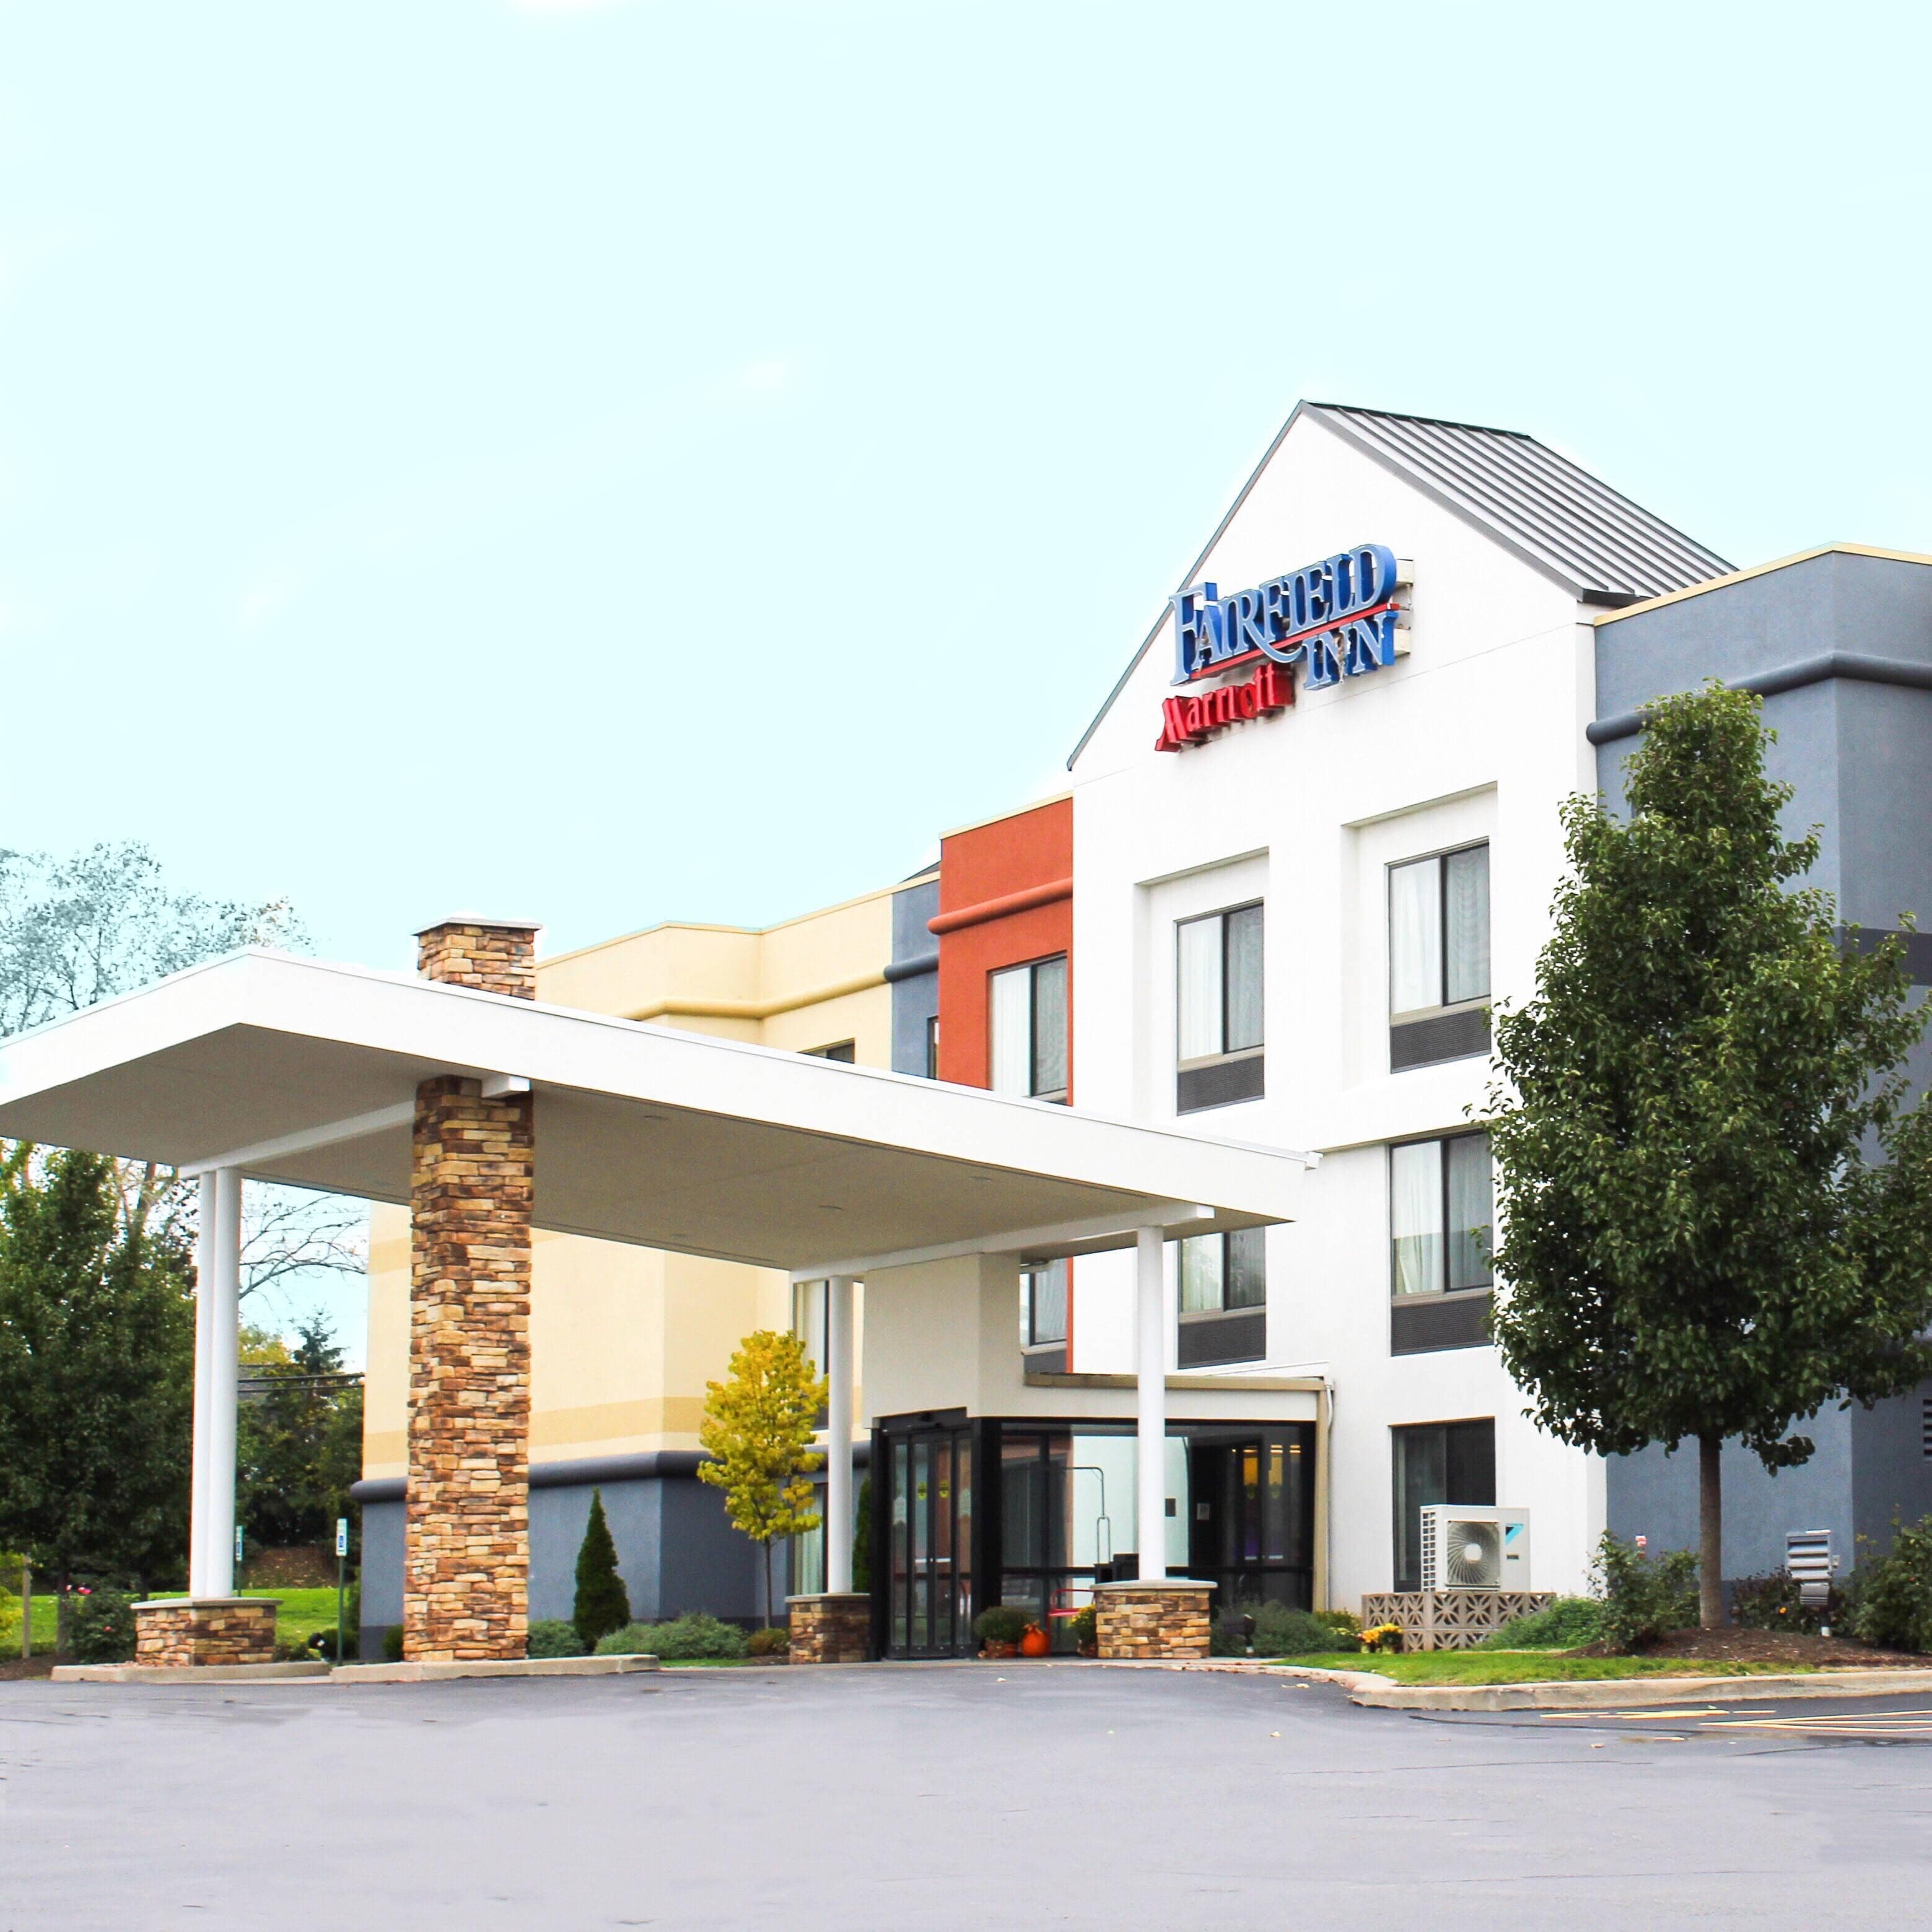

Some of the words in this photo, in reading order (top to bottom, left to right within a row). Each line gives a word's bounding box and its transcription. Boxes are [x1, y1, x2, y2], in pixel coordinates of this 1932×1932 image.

[1169, 544, 1396, 686] FAIRFIELD
[1301, 611, 1397, 690] INN
[1155, 662, 1295, 751] Marriott
